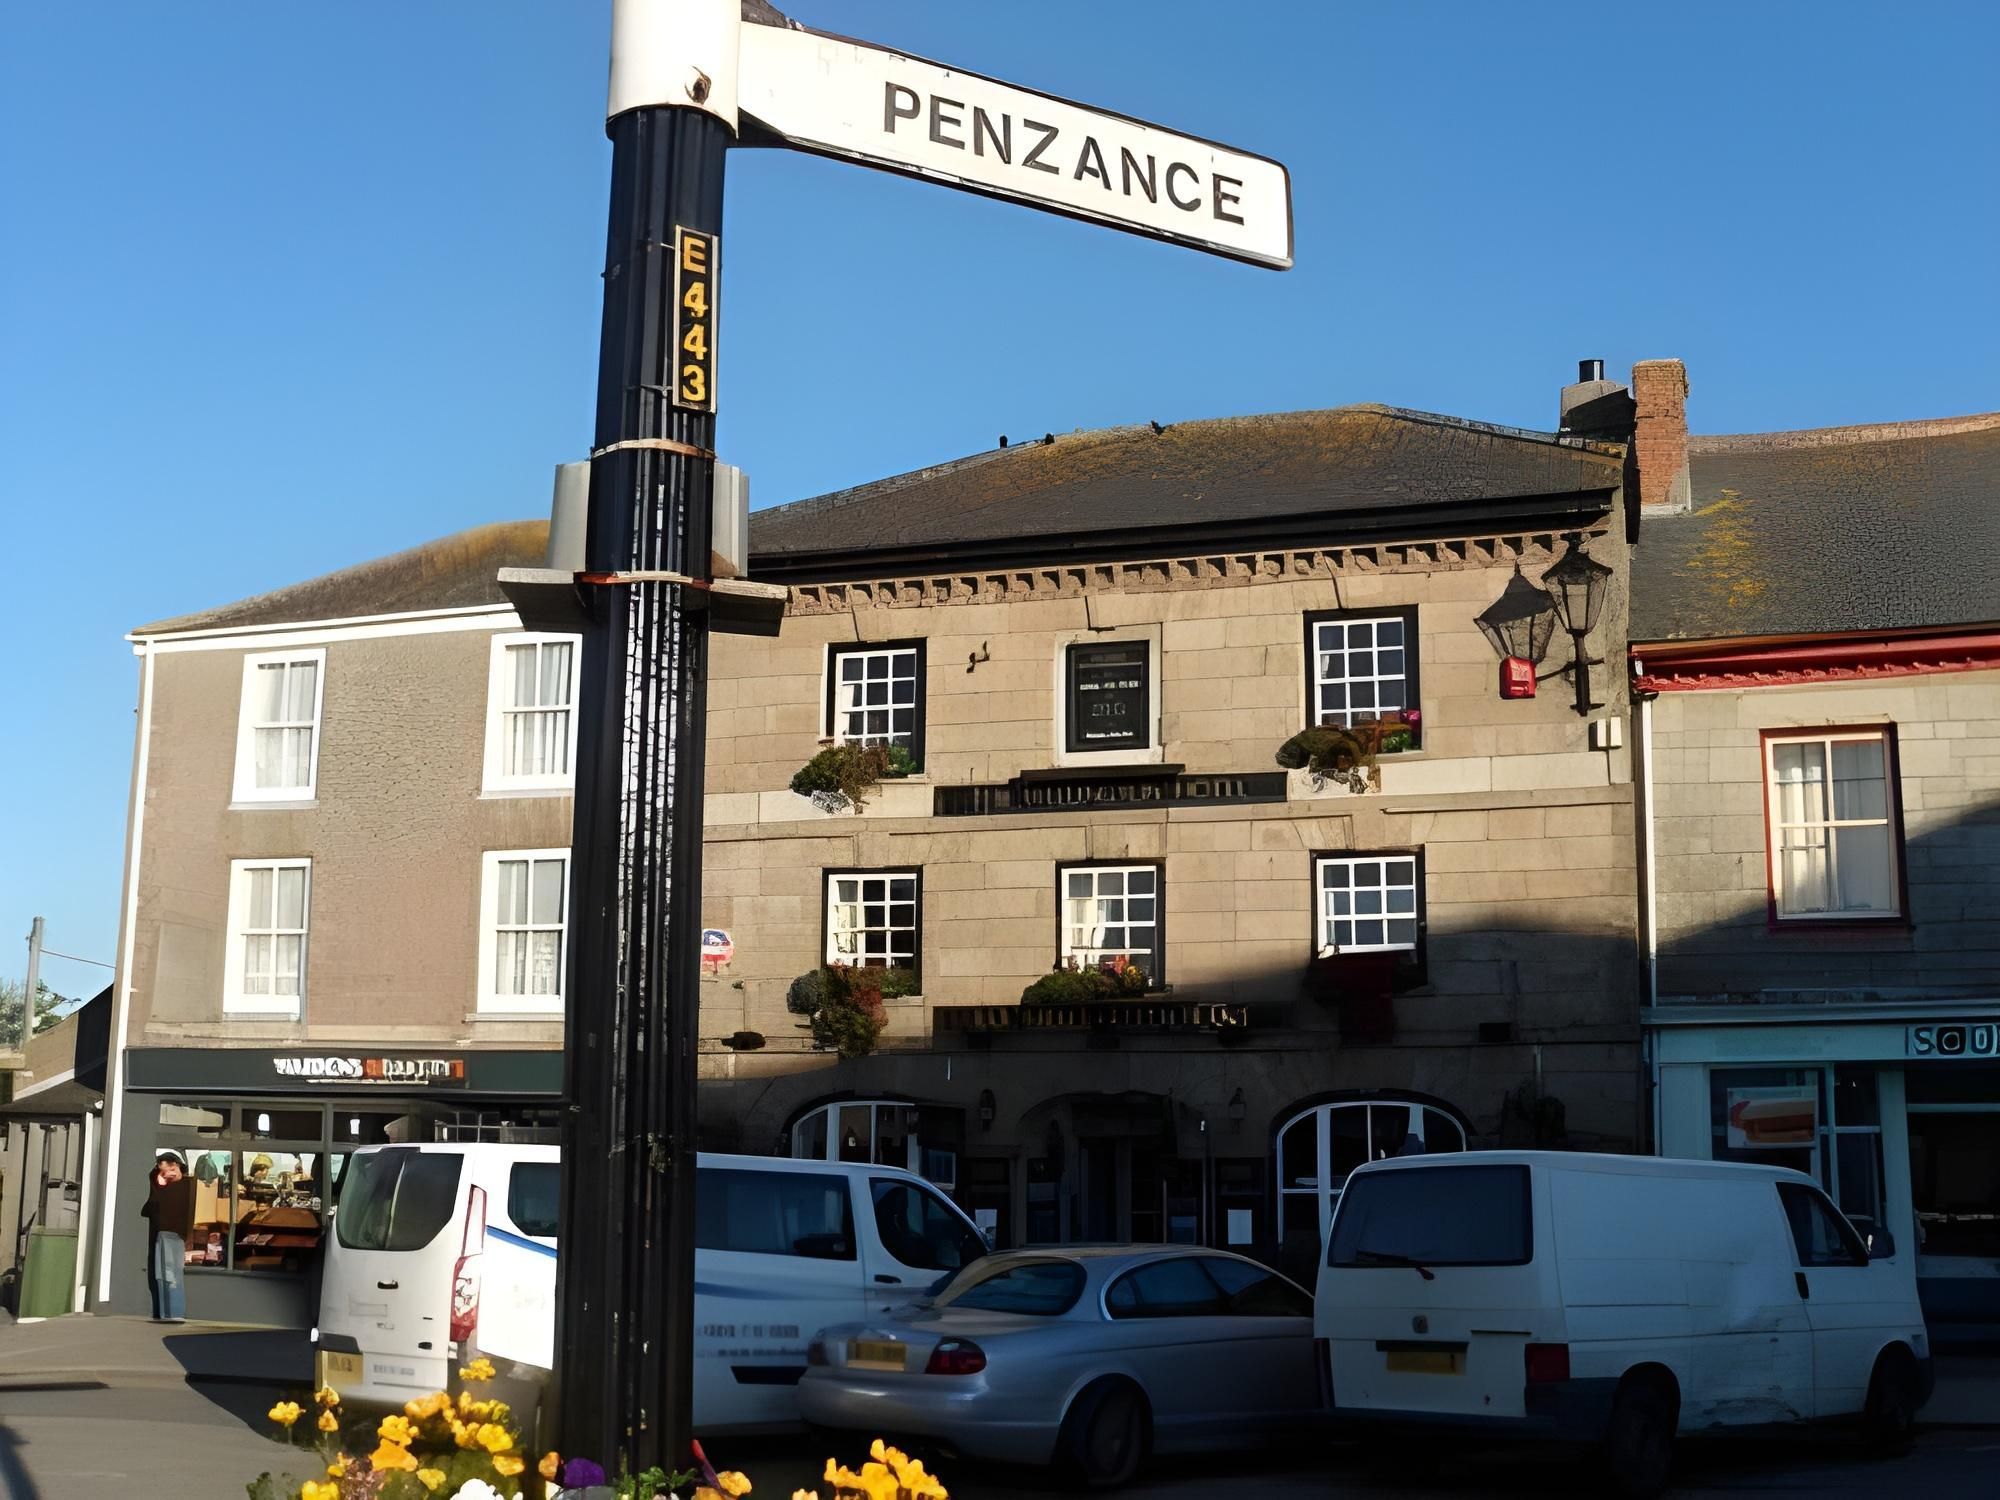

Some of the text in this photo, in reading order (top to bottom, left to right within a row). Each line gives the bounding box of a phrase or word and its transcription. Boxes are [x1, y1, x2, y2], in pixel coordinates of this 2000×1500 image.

[884, 81, 1245, 226] PENZANCE
[682, 235, 709, 402] E443
[1912, 1025, 2000, 1056] SOU
